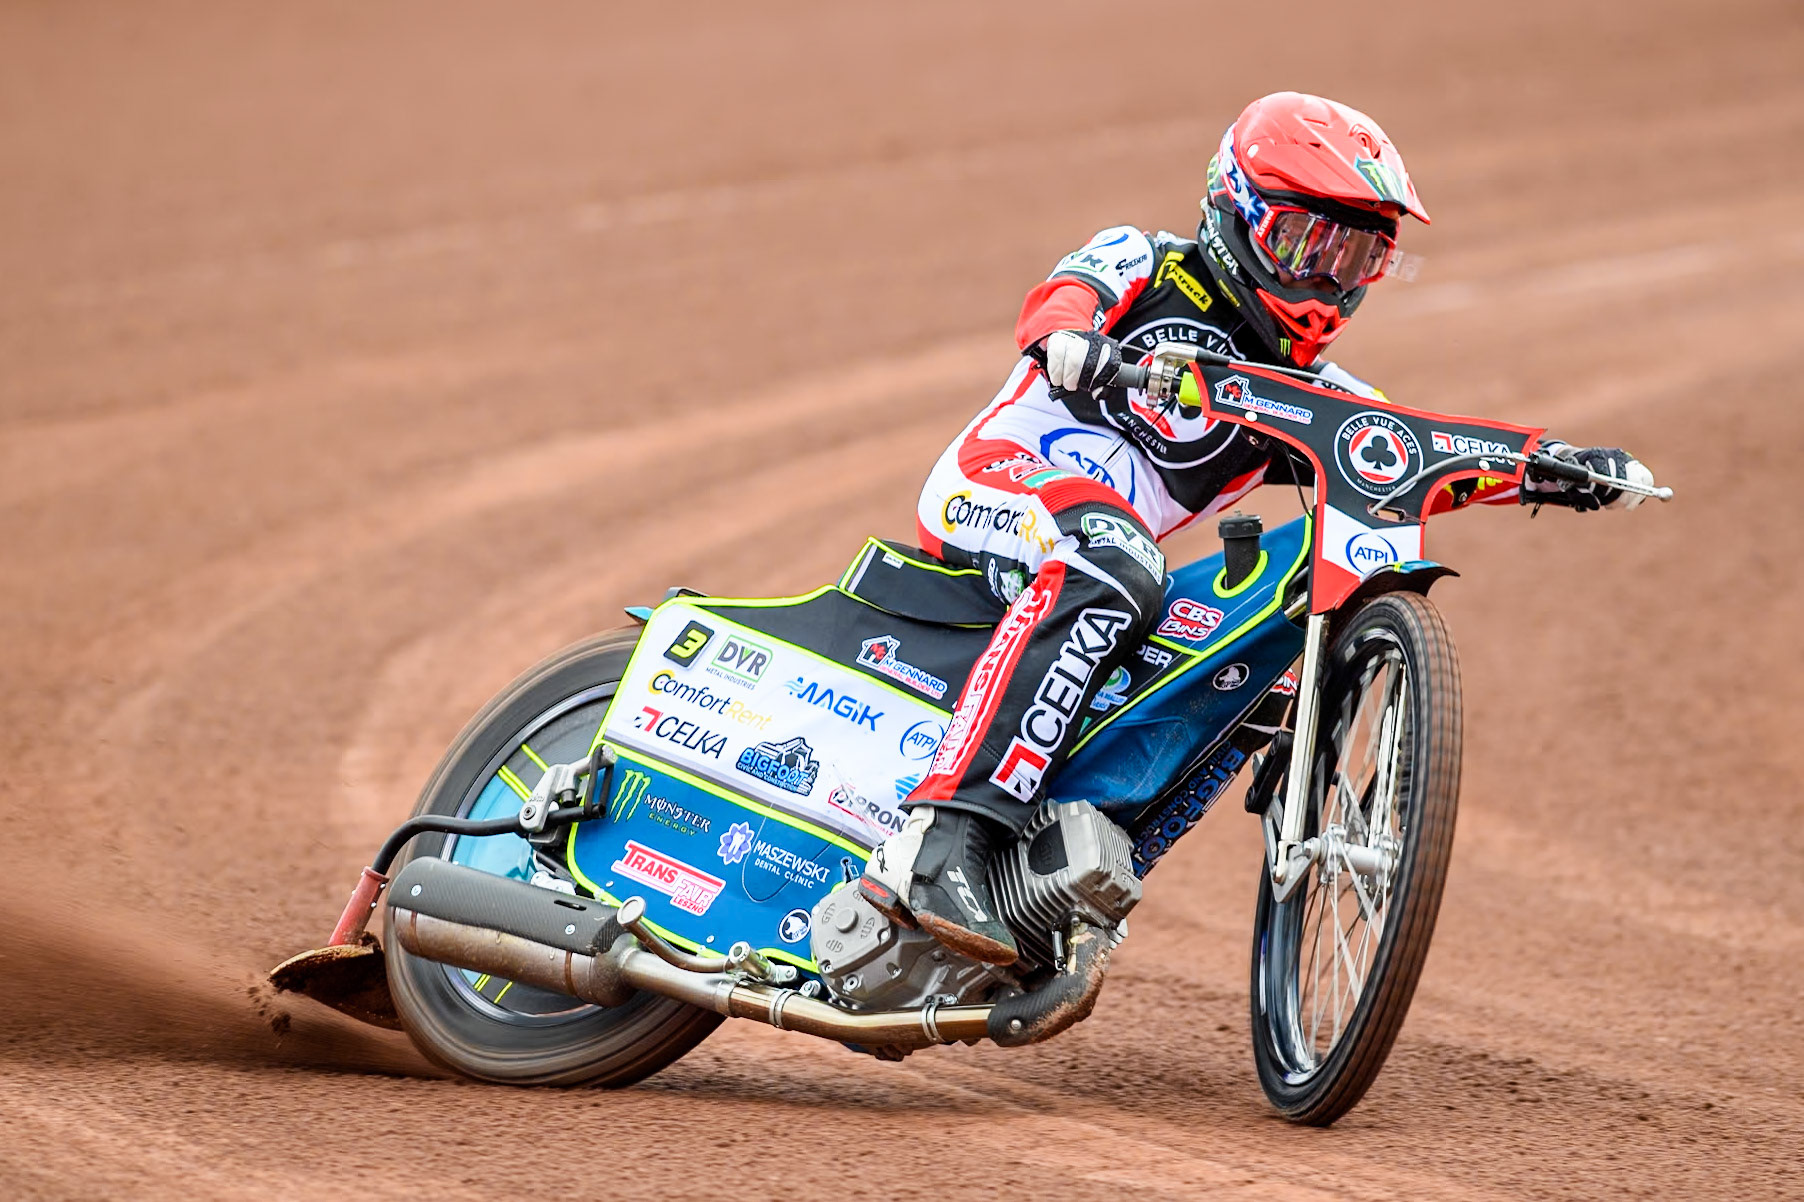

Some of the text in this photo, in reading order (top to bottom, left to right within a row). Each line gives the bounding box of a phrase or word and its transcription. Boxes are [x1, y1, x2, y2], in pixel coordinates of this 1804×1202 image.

[1142, 327, 1198, 348] BELLE
[1256, 399, 1311, 418] GENNARD
[1342, 416, 1417, 455] BELLE VUE ACES
[1089, 519, 1159, 565] DVR
[1354, 546, 1388, 563] ATPI
[1162, 620, 1207, 637] BINS
[1172, 602, 1219, 629] CBS
[670, 628, 708, 658] 3
[718, 640, 768, 677] DVR
[706, 666, 756, 691] METAL INDUSTRIES
[894, 661, 946, 692] GENNARD
[1026, 612, 1128, 748] CELKA
[656, 716, 728, 759] CELKA
[907, 731, 938, 751] ATPI
[740, 747, 809, 786] BIGFOOT
[1187, 767, 1208, 790] AND
[648, 812, 697, 836] ENERGY
[623, 843, 679, 884] TRANS
[753, 839, 830, 883] MASZEWSKI
[755, 857, 814, 889] DENTAL CLINIC
[673, 877, 714, 908] FAIR
[673, 897, 704, 914] LESZNO
